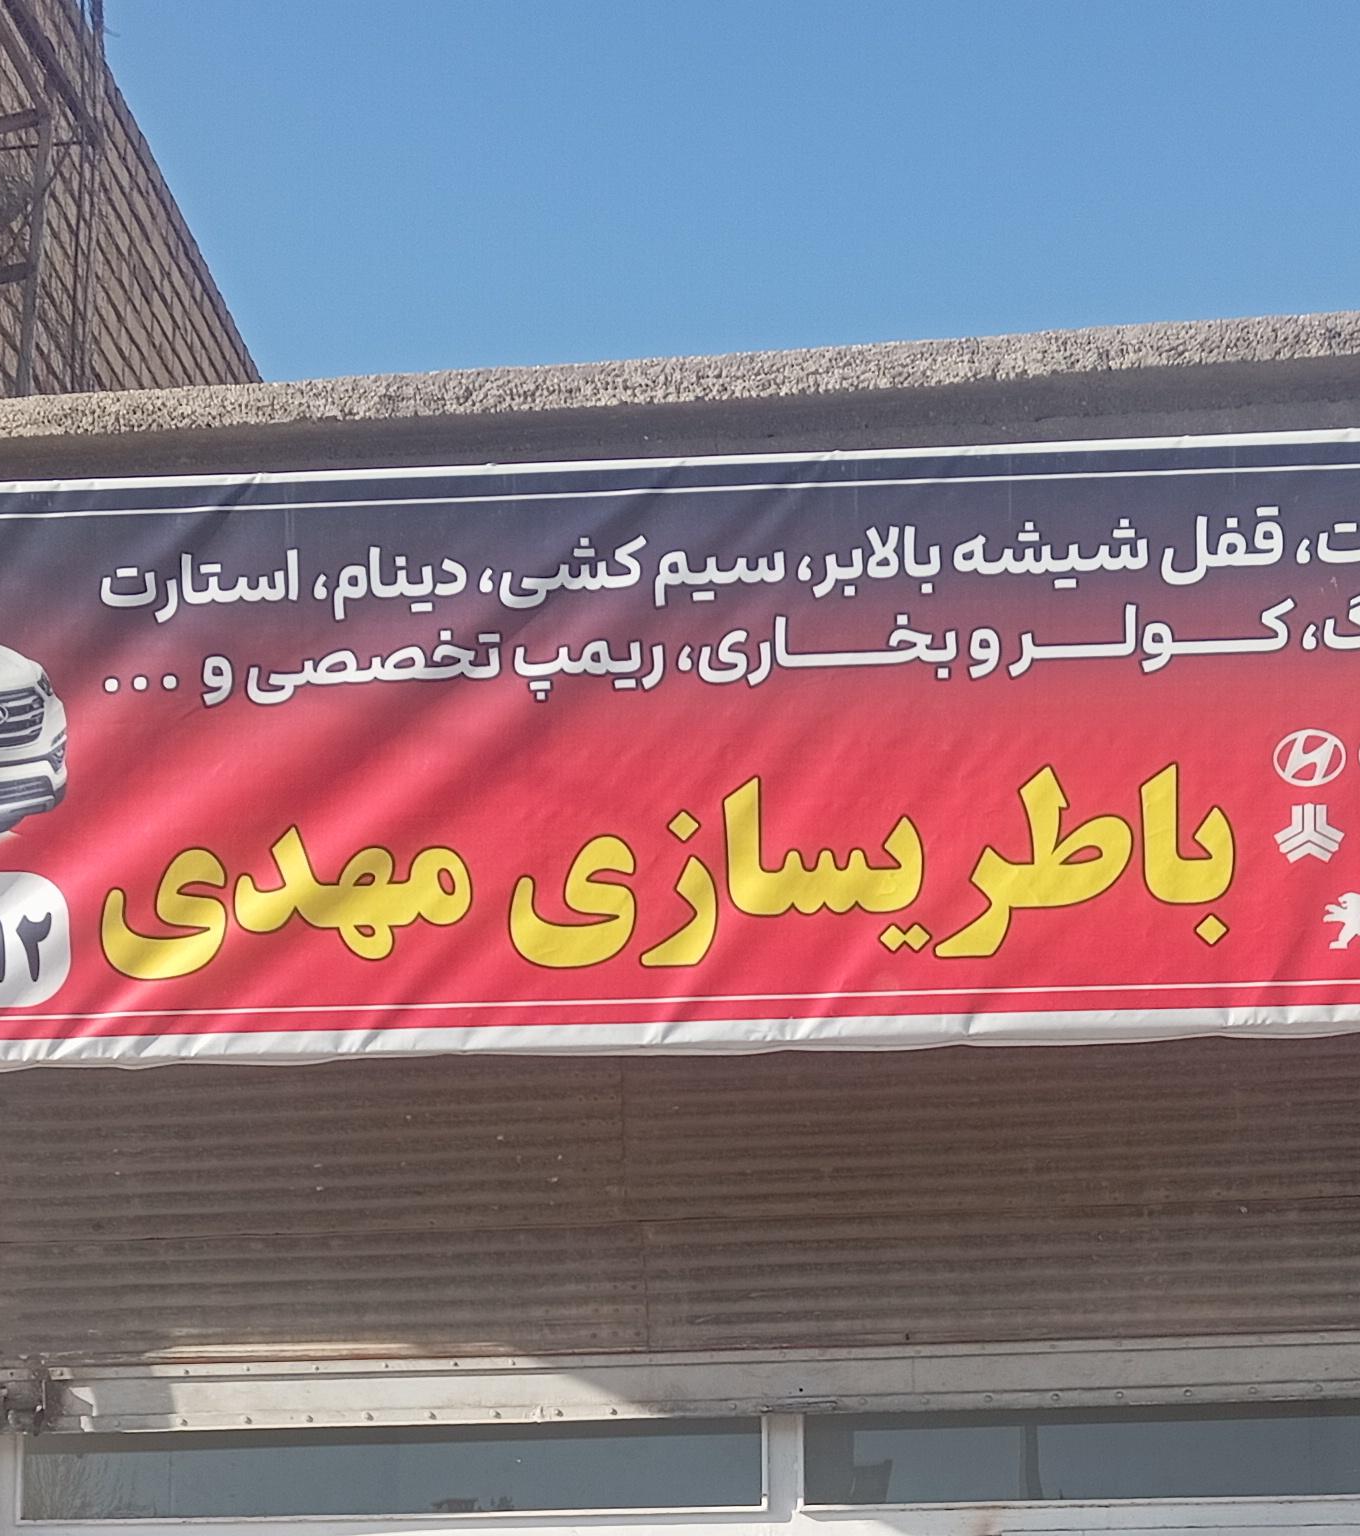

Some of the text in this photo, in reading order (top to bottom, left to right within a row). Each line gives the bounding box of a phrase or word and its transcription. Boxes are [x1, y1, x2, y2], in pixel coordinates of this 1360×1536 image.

[952, 517, 1150, 590] شیشه
[1160, 505, 1285, 577] قفل
[99, 548, 300, 625] استارت
[653, 547, 786, 608] سیم
[244, 630, 503, 706] تخصصی
[512, 636, 666, 702] ریمپ
[967, 628, 1000, 682] و
[1009, 598, 1296, 678] کولر
[200, 652, 233, 706] و
[99, 824, 473, 982] مهدی
